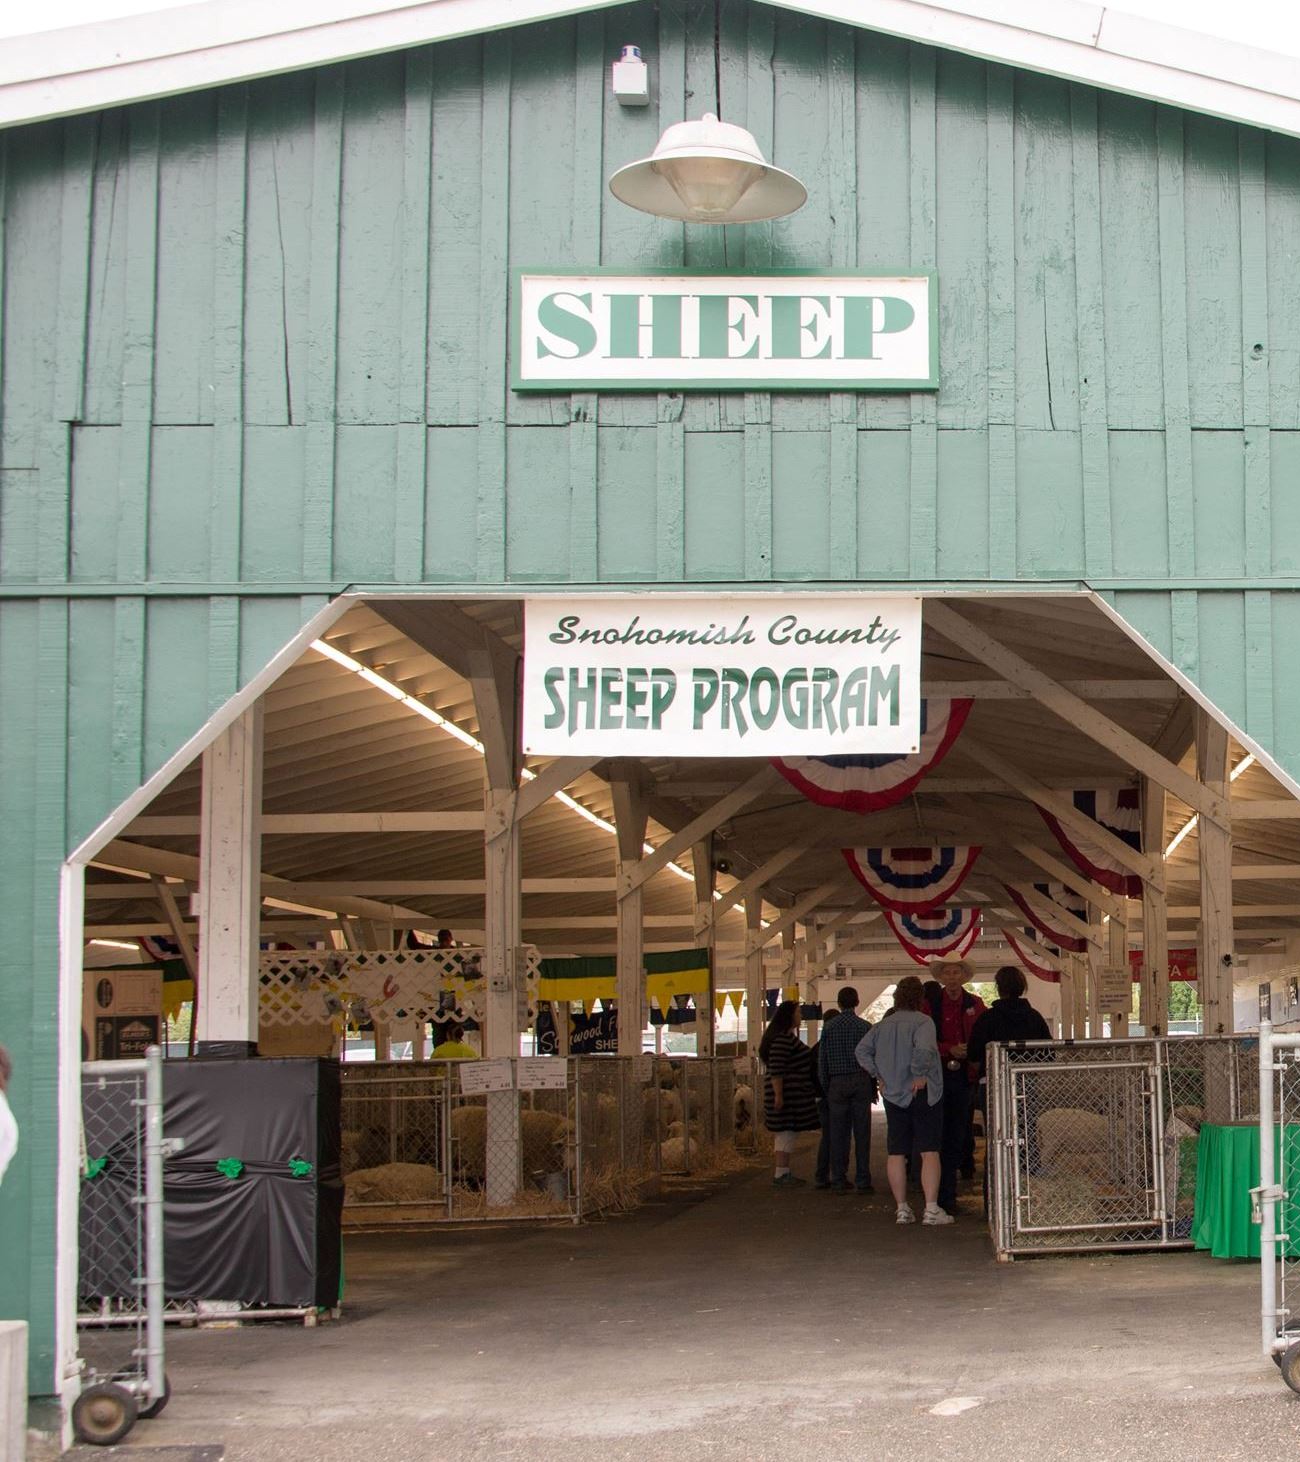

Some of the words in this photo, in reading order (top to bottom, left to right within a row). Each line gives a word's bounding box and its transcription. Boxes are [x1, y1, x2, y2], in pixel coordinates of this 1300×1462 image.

[537, 292, 915, 360] SHEEP
[548, 615, 756, 646] Snohomish
[767, 615, 902, 653] County
[543, 665, 677, 738] SHEEP
[692, 664, 901, 738] PROGRAM
[595, 1040, 618, 1050] SHE
